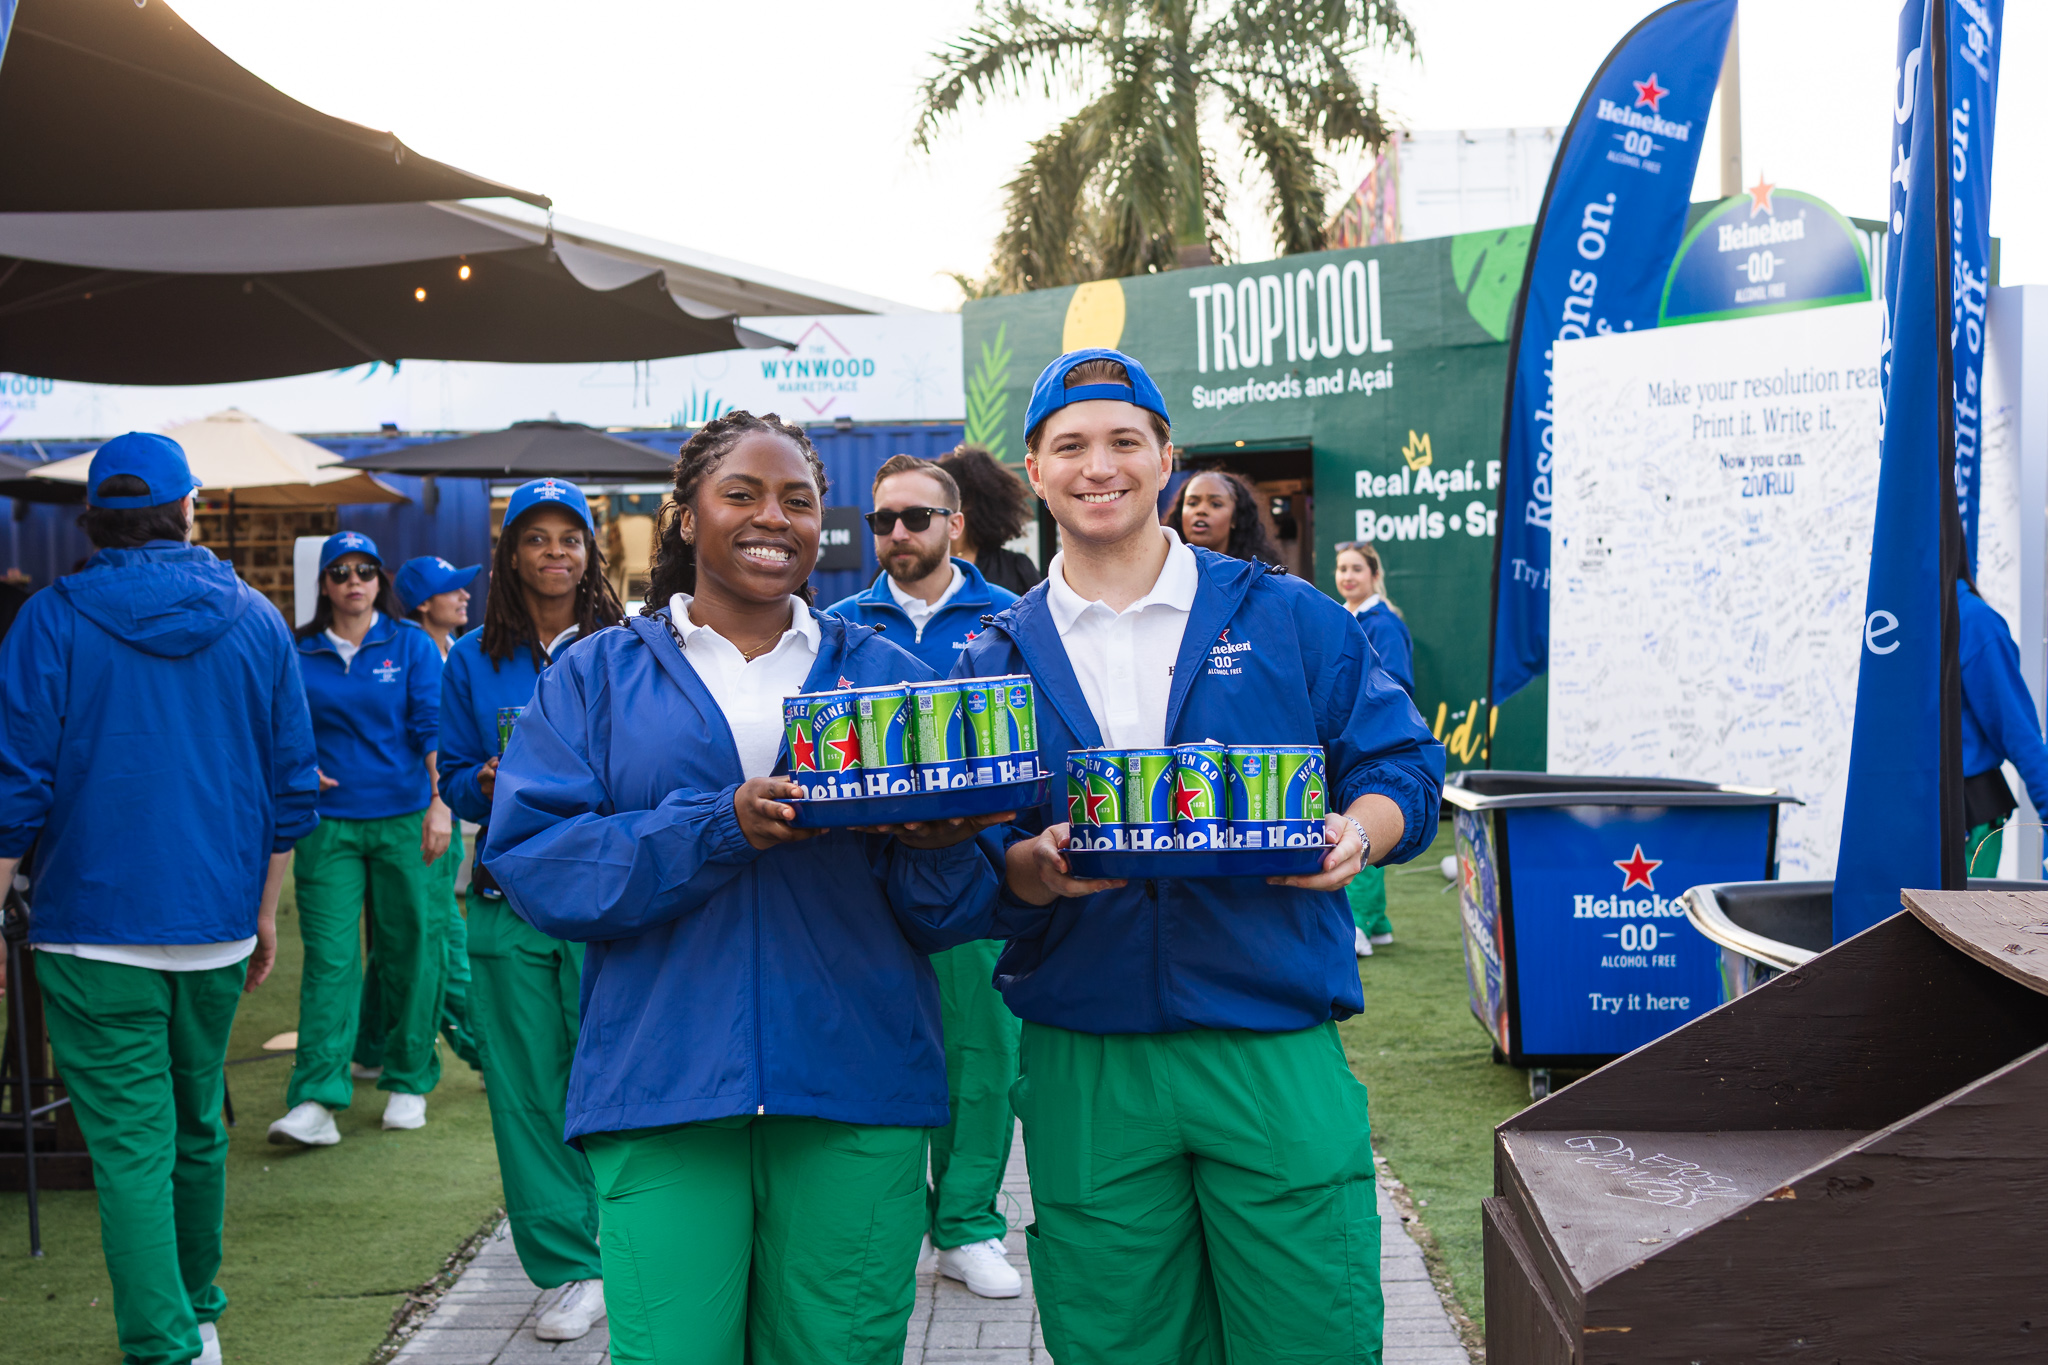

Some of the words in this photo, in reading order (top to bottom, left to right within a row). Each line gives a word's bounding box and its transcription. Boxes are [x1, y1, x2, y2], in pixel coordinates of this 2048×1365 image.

[1597, 98, 1690, 142] Heineken
[1624, 130, 1653, 157] 0.0
[1577, 192, 1617, 260] on.
[1718, 216, 1805, 252] Heineken
[1747, 250, 1774, 283] 0.0
[1767, 282, 1787, 299] FREE
[1189, 258, 1394, 373] TROPICOOL
[1961, 259, 1988, 355] off.
[761, 358, 875, 379] WYNWOOD
[777, 381, 858, 393] MARKETPLACE
[1192, 373, 1301, 410] Superfoods
[1305, 368, 1344, 397] and
[1648, 379, 1691, 407] Make
[1697, 381, 1738, 409] your
[1744, 368, 1839, 399] resolution
[1693, 414, 1734, 439] Print
[1741, 410, 1757, 436] it.
[1763, 407, 1813, 433] Write
[1820, 404, 1837, 430] it.
[1719, 453, 1746, 470] Now
[1750, 455, 1774, 472] you
[1777, 453, 1806, 467] can.
[1355, 465, 1410, 498] Real
[1413, 459, 1482, 502] Açaí.
[1355, 504, 1445, 542] Bowls
[1512, 559, 1540, 589] Try
[1214, 656, 1232, 669] 0.0
[1230, 667, 1242, 675] FREE
[1105, 766, 1123, 785] 0.0
[1200, 761, 1218, 780] 0.0
[1620, 924, 1658, 951] 0.0
[1601, 955, 1649, 968] ALCOHOL
[1652, 954, 1677, 968] FREE
[1589, 992, 1623, 1015] Try
[1628, 993, 1641, 1011] it
[1646, 992, 1690, 1011] here
